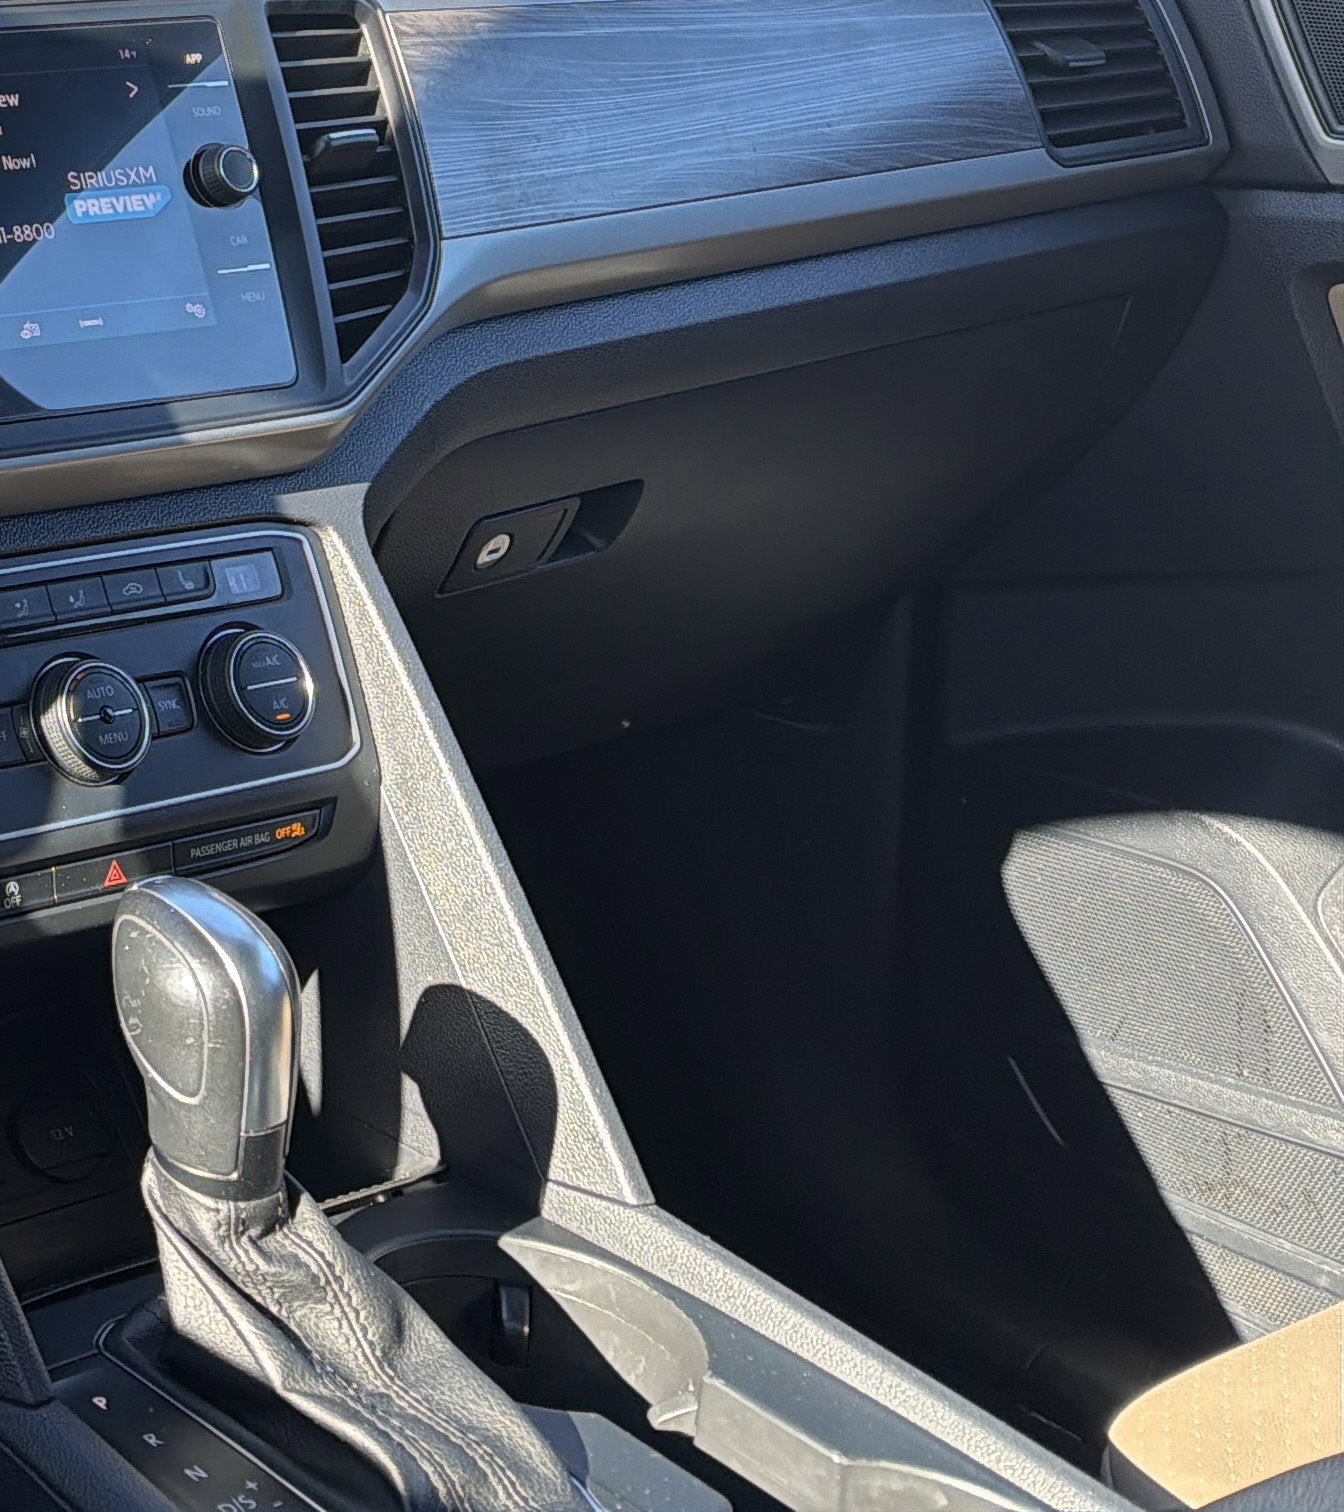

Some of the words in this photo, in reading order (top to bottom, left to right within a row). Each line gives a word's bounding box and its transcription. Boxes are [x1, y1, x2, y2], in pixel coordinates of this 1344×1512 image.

[184, 52, 203, 65] APP
[191, 105, 222, 118] SOUND
[2, 153, 37, 171] Now!
[67, 164, 157, 190] SIRIUSXM
[73, 192, 162, 218] PREVIEW
[229, 235, 249, 247] CAR
[86, 685, 115, 700] AUTO
[157, 698, 182, 712] SYNC
[272, 697, 289, 710] A/C
[98, 730, 129, 746] MENU
[190, 838, 239, 859] PASSENGER
[239, 835, 254, 849] AIR
[253, 831, 271, 846] BAG
[275, 826, 293, 840] OFF
[3, 894, 22, 910] OFF
[91, 1395, 108, 1410] P
[142, 1432, 165, 1448] R
[183, 1464, 209, 1482] N
